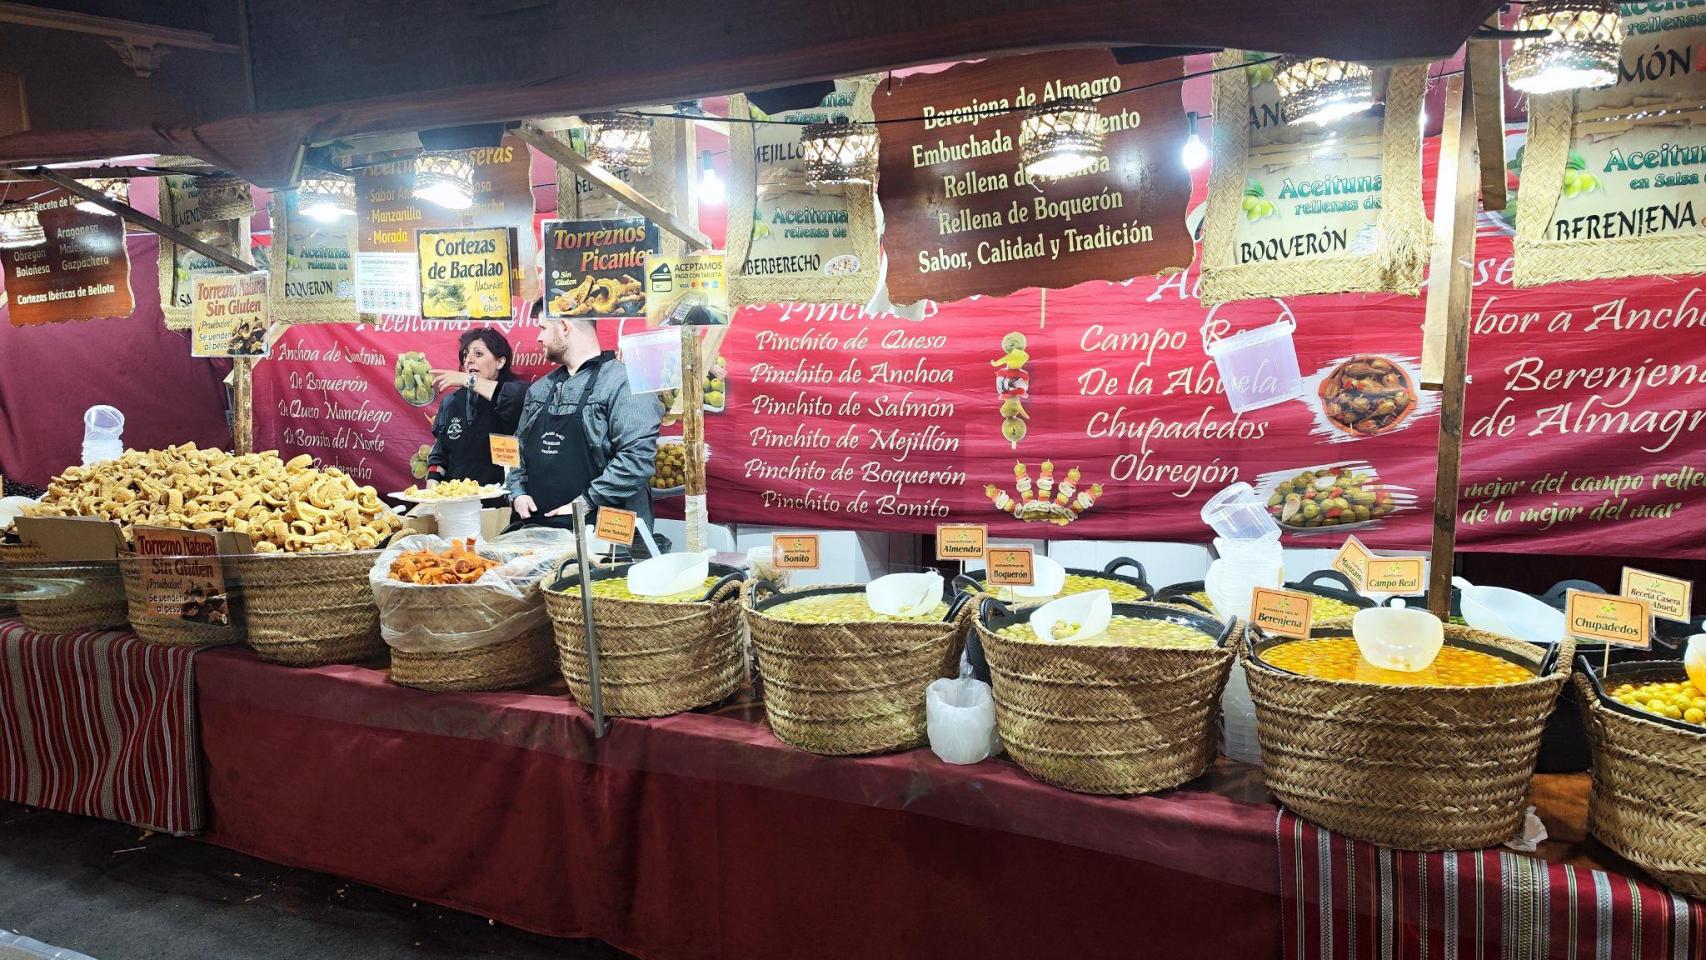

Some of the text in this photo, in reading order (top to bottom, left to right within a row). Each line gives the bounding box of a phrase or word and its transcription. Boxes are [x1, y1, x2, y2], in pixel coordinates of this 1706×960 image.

[923, 75, 1121, 130] Berenjena de Almagro
[912, 134, 1013, 168] Embuchada
[944, 170, 1009, 199] Rellena
[1278, 174, 1383, 200] Aceituna
[1629, 172, 1699, 190] en Salsa
[34, 200, 58, 213] Receta
[59, 198, 69, 208] de
[372, 207, 423, 224] Manzanilla
[772, 206, 849, 224] Aceituna
[939, 187, 1124, 235] Rellena de Boquerón
[1295, 198, 1359, 216] rellenas
[57, 224, 99, 240] Aragonesa
[373, 230, 408, 245] Morada
[554, 225, 646, 250] Torreznos
[784, 227, 848, 239] rellenas de
[435, 237, 496, 257] Cortezas
[918, 221, 1154, 275] Sabor, Calidad y Tradición
[1241, 225, 1347, 264] BOQUERÓN
[16, 264, 50, 278] Boloñesa
[427, 262, 446, 280] de
[450, 259, 504, 279] Bacalao
[561, 270, 572, 278] Sin
[675, 261, 723, 271] ACEPTAMOS
[744, 253, 822, 276] BERBERECHO
[197, 277, 267, 300] Torrezno Natural
[555, 278, 577, 286] Gluten
[17, 283, 115, 305] Cortezas Ibéricas de Bellota
[206, 300, 262, 317] Sin Gluten
[1547, 310, 1574, 333] a
[199, 331, 233, 342] Se venden
[204, 343, 212, 351] al
[756, 326, 948, 352] Pinchito de Queso
[1080, 324, 1189, 366] Campo
[278, 339, 320, 361] Anchoa
[323, 340, 342, 363] de
[750, 357, 955, 384] Pinchito de Anchoa
[1077, 366, 1119, 397] De
[1127, 361, 1154, 396] la
[290, 371, 369, 401] De Boquerón
[1503, 356, 1706, 409] Berenjen
[752, 391, 955, 418] Pinchito de Salmón
[325, 400, 393, 433] Manchego
[1469, 394, 1706, 453] de Almagr
[332, 427, 351, 450] del
[352, 432, 386, 453] Norte
[1086, 406, 1269, 454] Chupadedos
[750, 424, 960, 462] Pinchito de Mejillón
[744, 456, 967, 496] Pinchito de Boquerón
[1110, 450, 1241, 498] Obregón
[1464, 476, 1527, 504] mejor
[1531, 471, 1568, 494] del
[1571, 473, 1644, 498] campo
[761, 488, 951, 518] Pinchito de Bonito
[1462, 498, 1683, 532] de lo mejor del mar
[138, 535, 218, 557] Torrezno Natural
[944, 545, 981, 554] Almendra
[151, 558, 215, 578] Sin Gluten
[784, 553, 810, 562] Bonito
[993, 569, 1028, 579] Boquerón
[1369, 578, 1417, 590] Campo Real
[149, 593, 159, 603] Se
[1630, 587, 1655, 600] Receta
[1656, 594, 1681, 606] Casera
[1653, 602, 1677, 613] Abuela
[1258, 612, 1302, 628] Berenjena
[1575, 617, 1639, 636] Chupadedos
